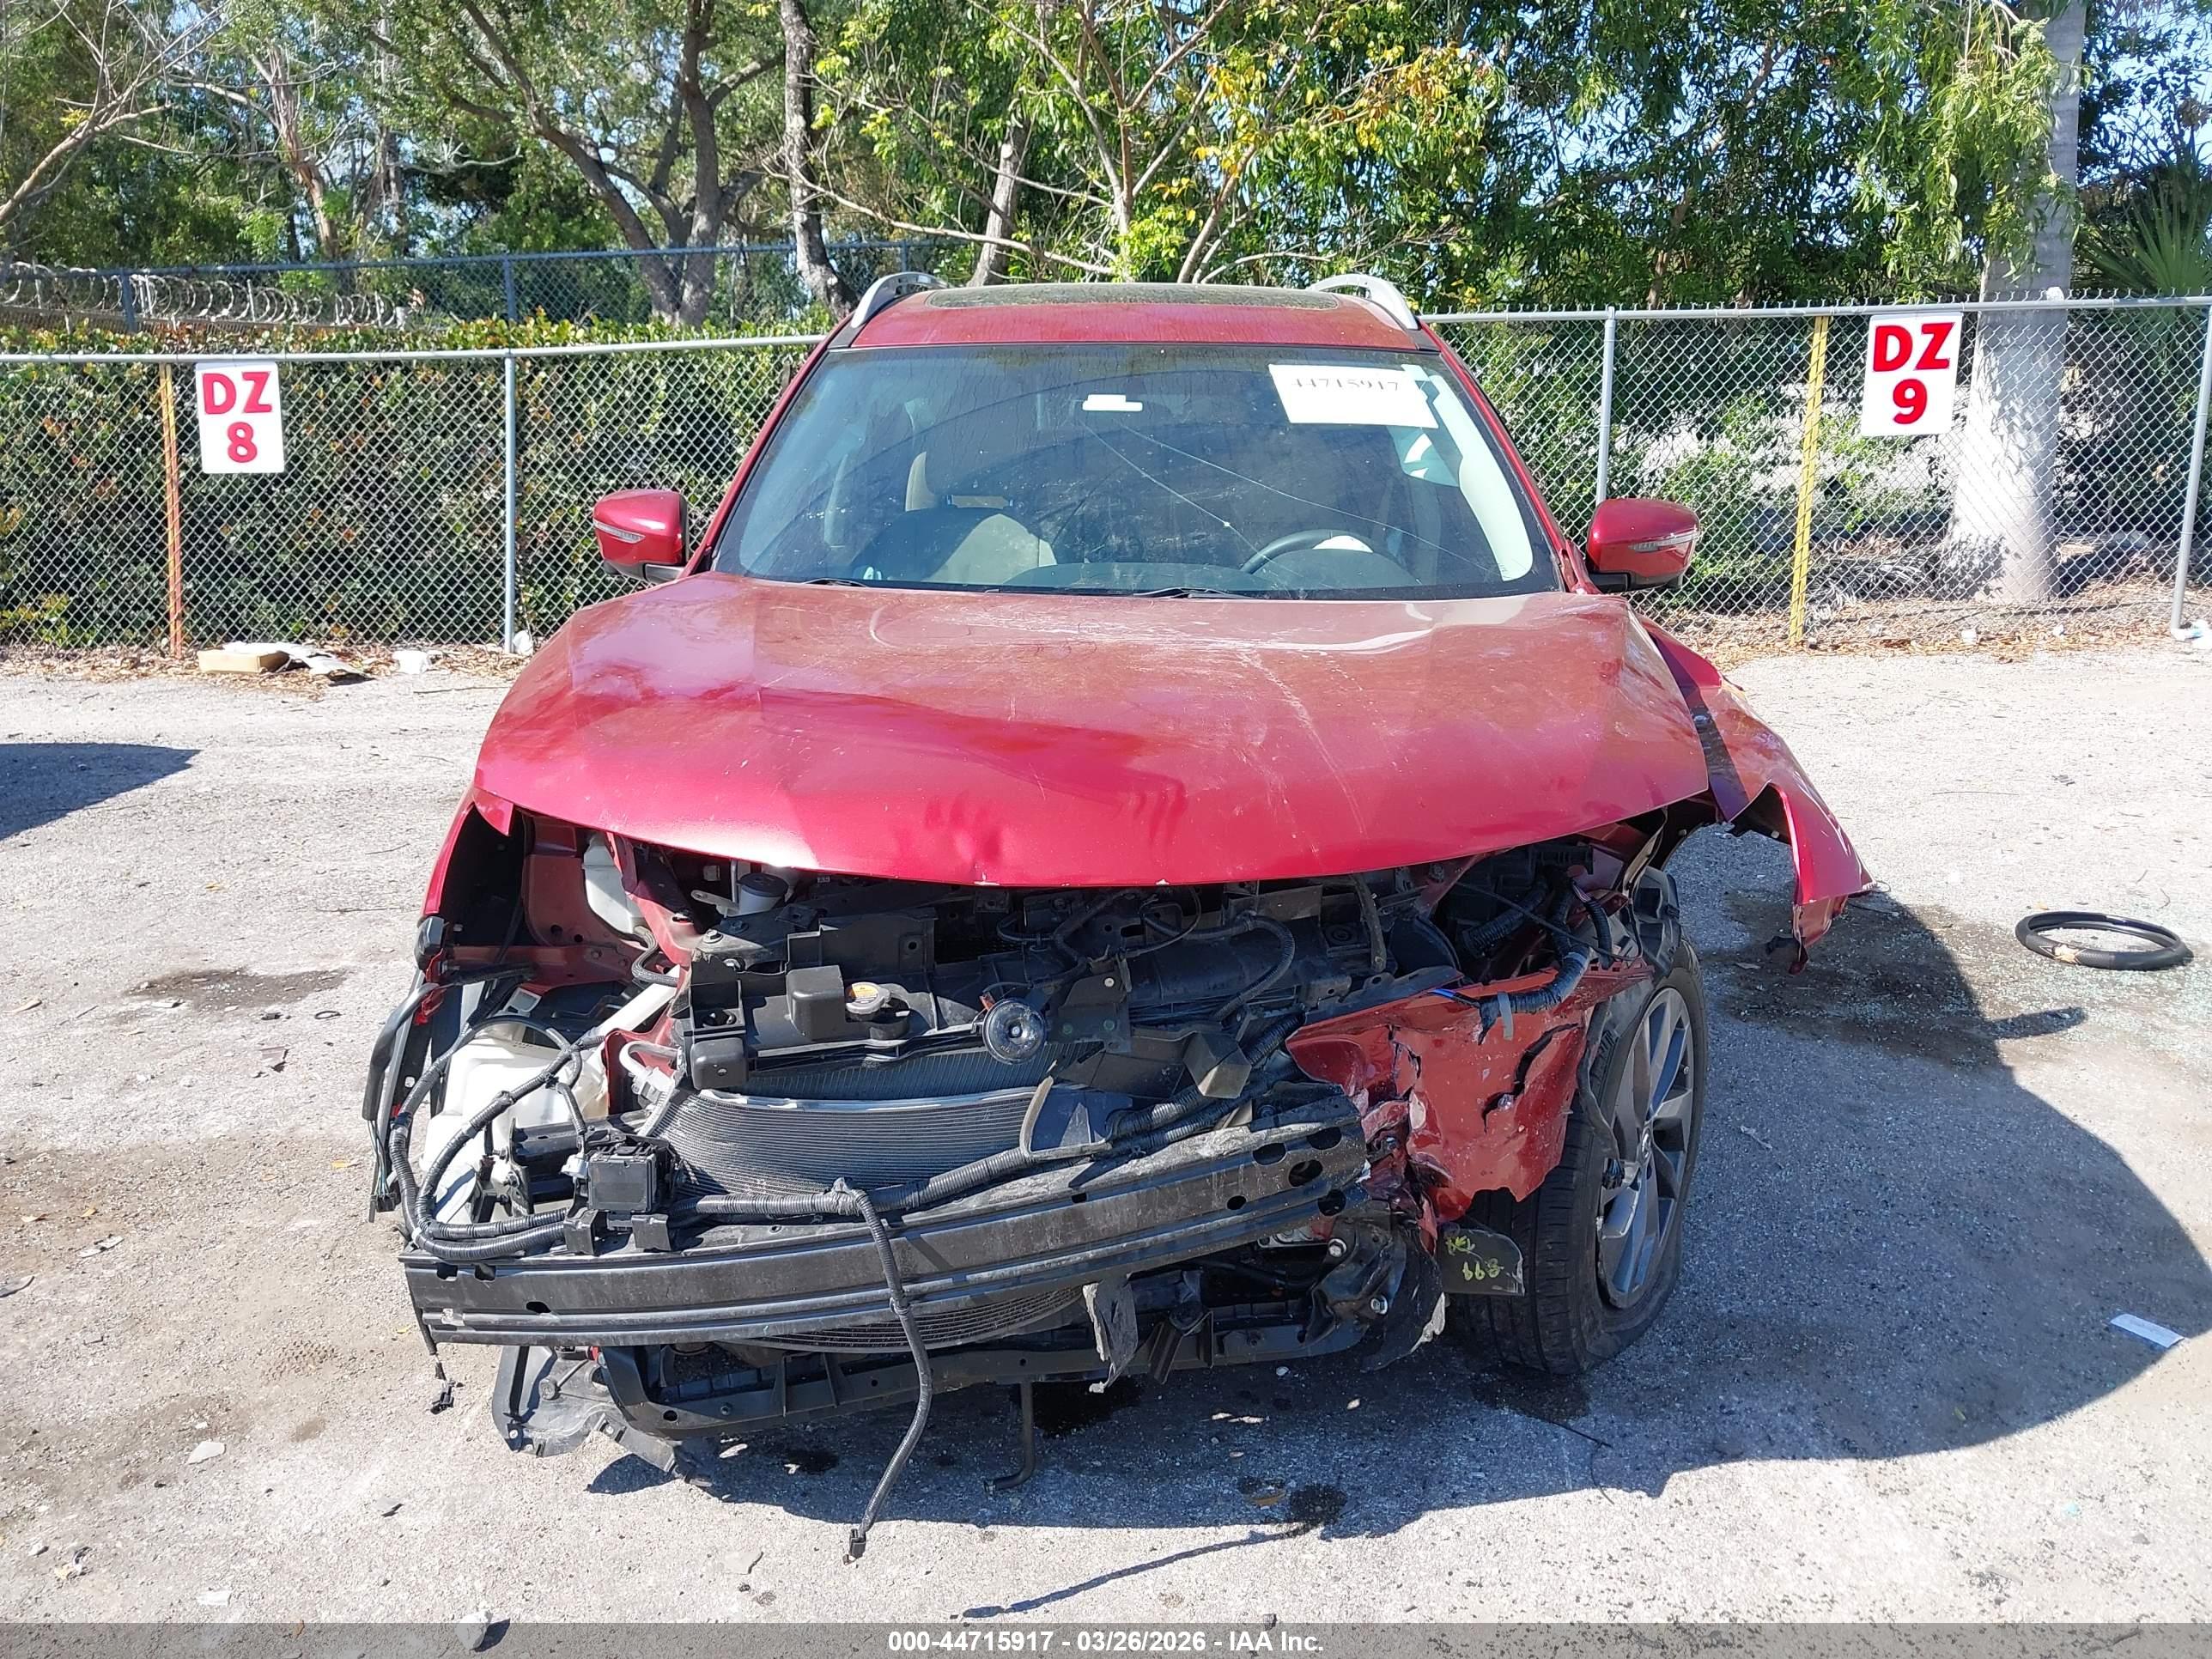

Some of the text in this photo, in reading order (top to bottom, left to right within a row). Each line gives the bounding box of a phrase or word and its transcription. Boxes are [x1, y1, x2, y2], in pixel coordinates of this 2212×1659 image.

[1873, 322, 1955, 372] DZ
[202, 371, 273, 415] DZ
[1893, 379, 1928, 425] 9
[228, 422, 258, 463] 8
